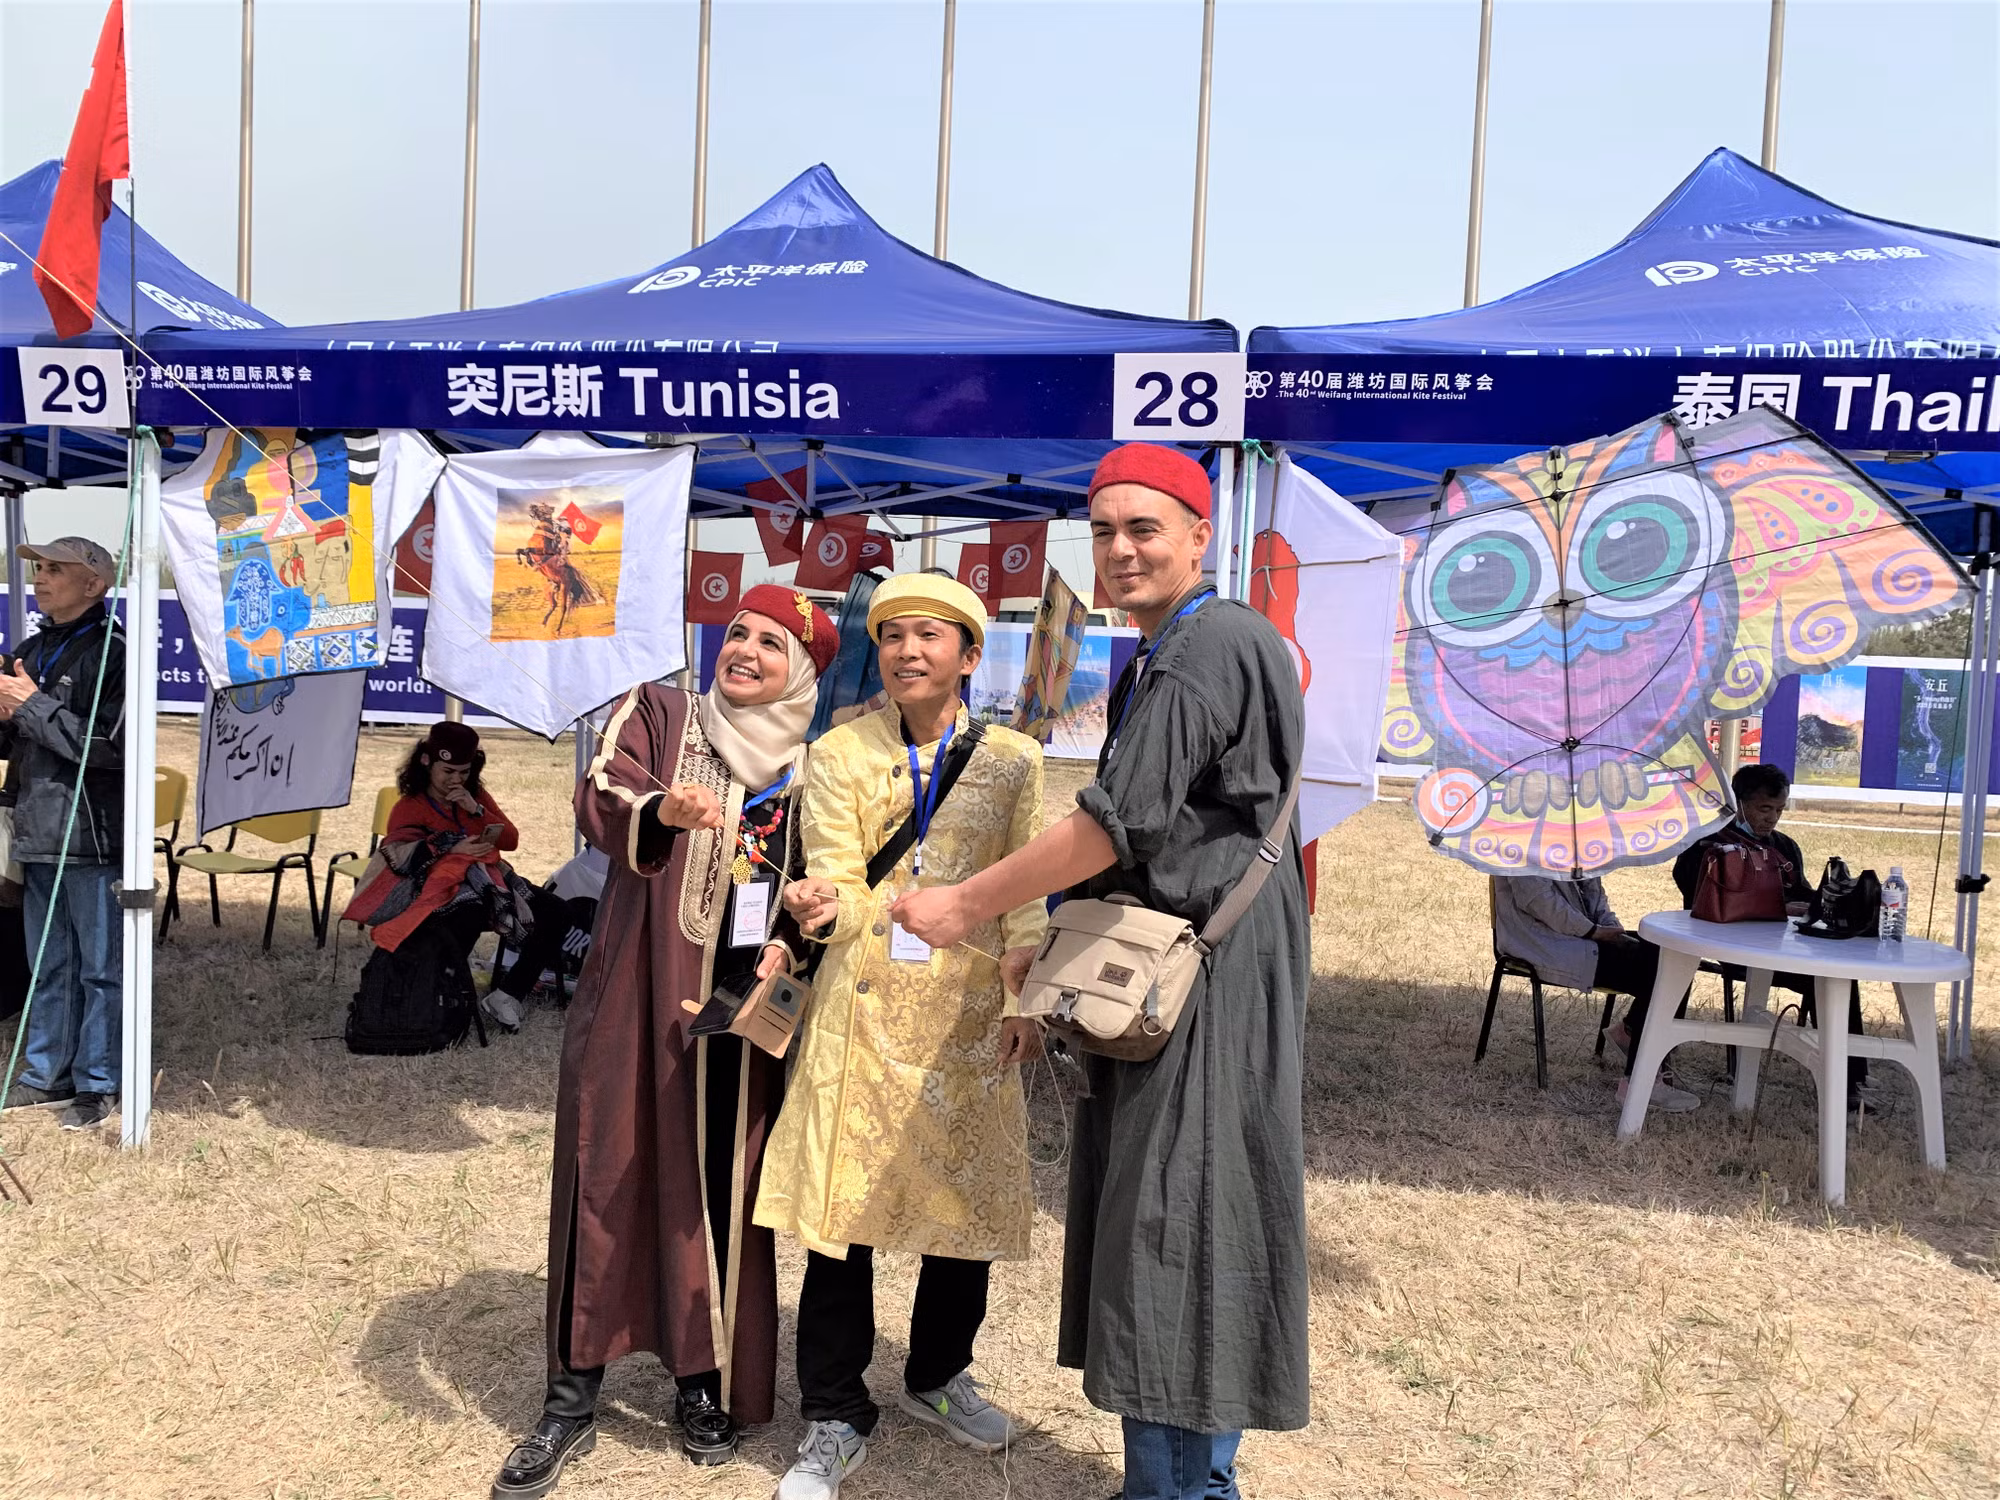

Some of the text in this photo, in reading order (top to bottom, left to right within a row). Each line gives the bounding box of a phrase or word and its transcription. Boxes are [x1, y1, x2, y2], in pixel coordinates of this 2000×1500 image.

[1724, 246, 1929, 269] 太平洋保险
[707, 260, 869, 278] 太平洋保险
[1738, 265, 1818, 277] CPIC
[698, 277, 761, 288] CPIC
[38, 364, 107, 415] 29
[207, 382, 250, 390] International
[252, 382, 265, 390] Kite
[266, 382, 293, 390] Festival
[1279, 370, 1494, 391] 第40届潍坊国际风筝会
[447, 363, 840, 419] 突尼斯 Tunisia
[1133, 371, 1219, 428] 28
[1318, 390, 1352, 400] Weifang
[1354, 391, 1411, 400] International
[1413, 392, 1430, 400] Kite
[1433, 392, 1467, 400] Festival
[1924, 678, 1948, 692] 安丘
